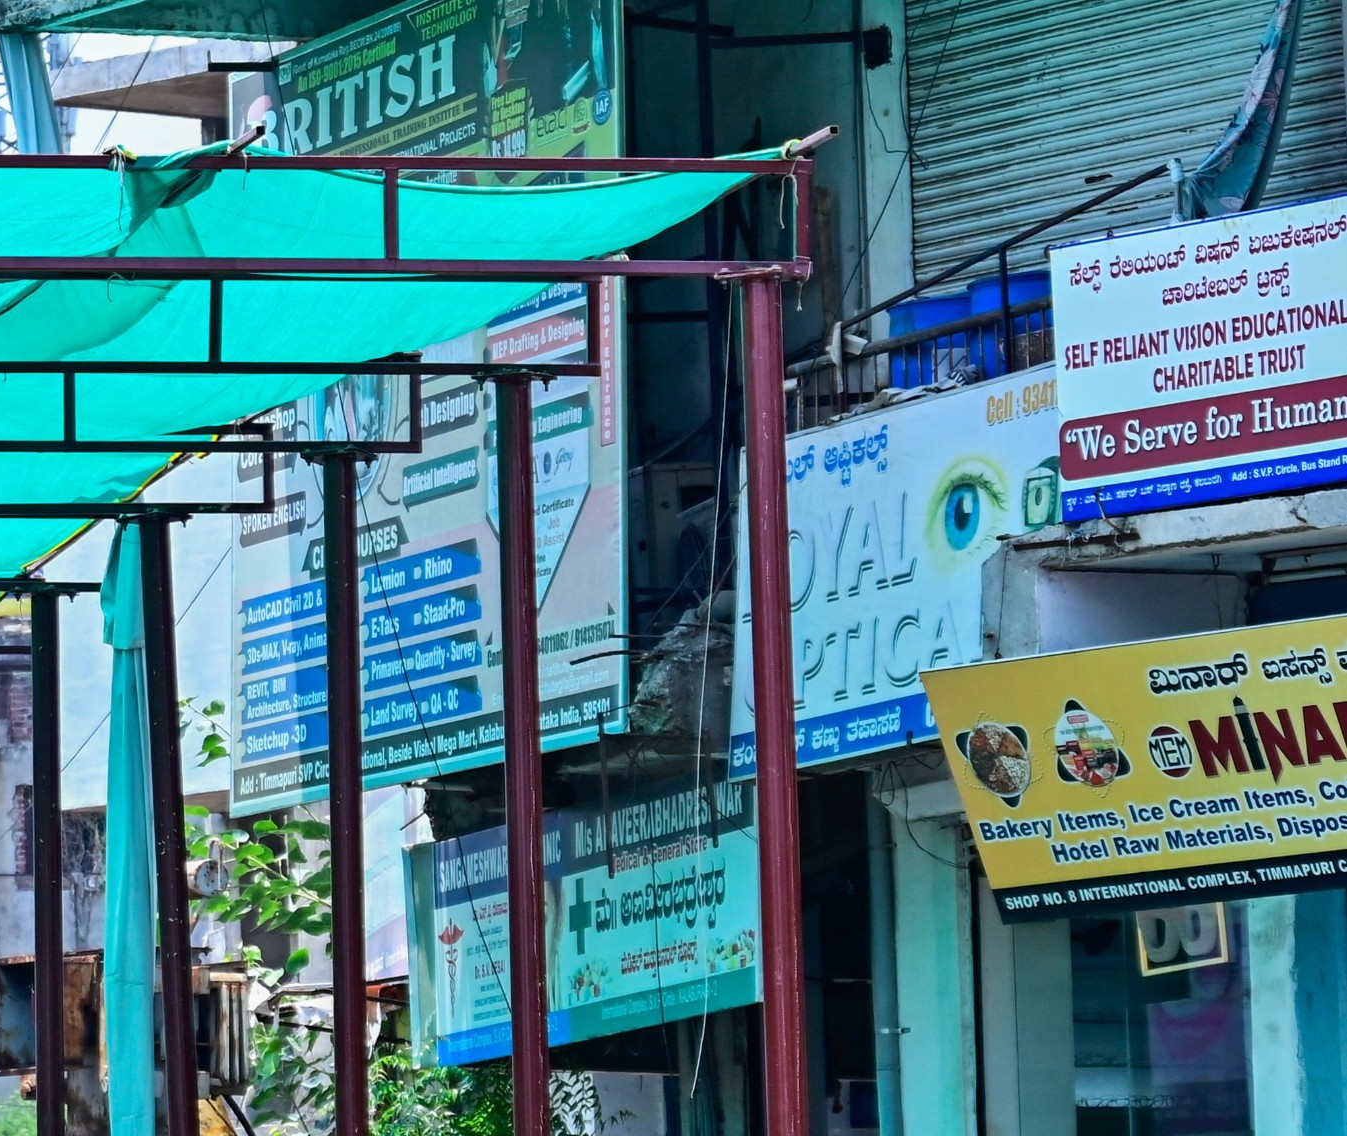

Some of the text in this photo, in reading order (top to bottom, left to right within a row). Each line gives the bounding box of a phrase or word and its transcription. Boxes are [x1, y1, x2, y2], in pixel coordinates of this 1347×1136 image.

[421, 6, 478, 41] TECHNOLOGY
[258, 34, 456, 156] BRITISH
[595, 99, 610, 116] IAF
[1194, 233, 1240, 266] ವಿಷನ್
[1162, 269, 1248, 306] ಚಾರಿಟೇಬಲ್
[509, 331, 539, 356] Drafting
[548, 317, 585, 343] Designing
[1064, 299, 1347, 371] SELF RELIANT VISION EDUCATIONAL
[1153, 344, 1306, 393] CHARITABLE TRUST
[430, 391, 475, 425] Designing
[538, 406, 582, 433] Engineering
[987, 378, 1057, 426] Cell 9341
[1124, 418, 1198, 455] Serve
[1206, 406, 1243, 441] for
[1251, 395, 1347, 434] Human
[403, 459, 476, 496] Artificial Intelligence
[1232, 471, 1248, 483] Add
[1301, 459, 1317, 472] Bus
[1318, 456, 1342, 470] Stand
[273, 503, 306, 527] ENGLISH
[541, 497, 574, 515] Certificate
[371, 556, 452, 594] Lumion Rhino
[247, 588, 323, 625] AutoCAD Civil 2D &
[423, 598, 466, 625] Staad-Pro
[304, 632, 327, 651] Anima
[415, 646, 445, 671] Quantity
[451, 639, 477, 662] Survey
[272, 676, 287, 693] BIM
[1148, 652, 1249, 695] ಮಿನಾರ್
[247, 698, 292, 720] Architecture,
[371, 708, 390, 727] Land
[391, 700, 418, 723] Survey
[240, 776, 255, 796] Add
[259, 766, 298, 791] Timmapuri
[298, 763, 313, 783] SVP
[314, 761, 329, 780] Circ
[388, 745, 412, 766] Beside
[437, 732, 457, 756] Mega
[479, 722, 505, 743] Kalabu
[247, 731, 289, 755] Sketchup
[979, 815, 1053, 843] Bakery
[1057, 806, 1126, 836] Items,
[1128, 803, 1165, 825] Ice
[1168, 793, 1241, 819] Cream
[1244, 784, 1315, 811] Items,
[1051, 813, 1347, 864] Hotel Raw Materials, Dispos
[1005, 894, 1040, 911] SHOP
[1043, 891, 1068, 907] NO.
[1068, 890, 1077, 904] 8
[1078, 877, 1186, 903] INTERNATIONAL
[1187, 870, 1257, 892] COMPLEX,
[1257, 860, 1337, 883] TIMMAPURI
